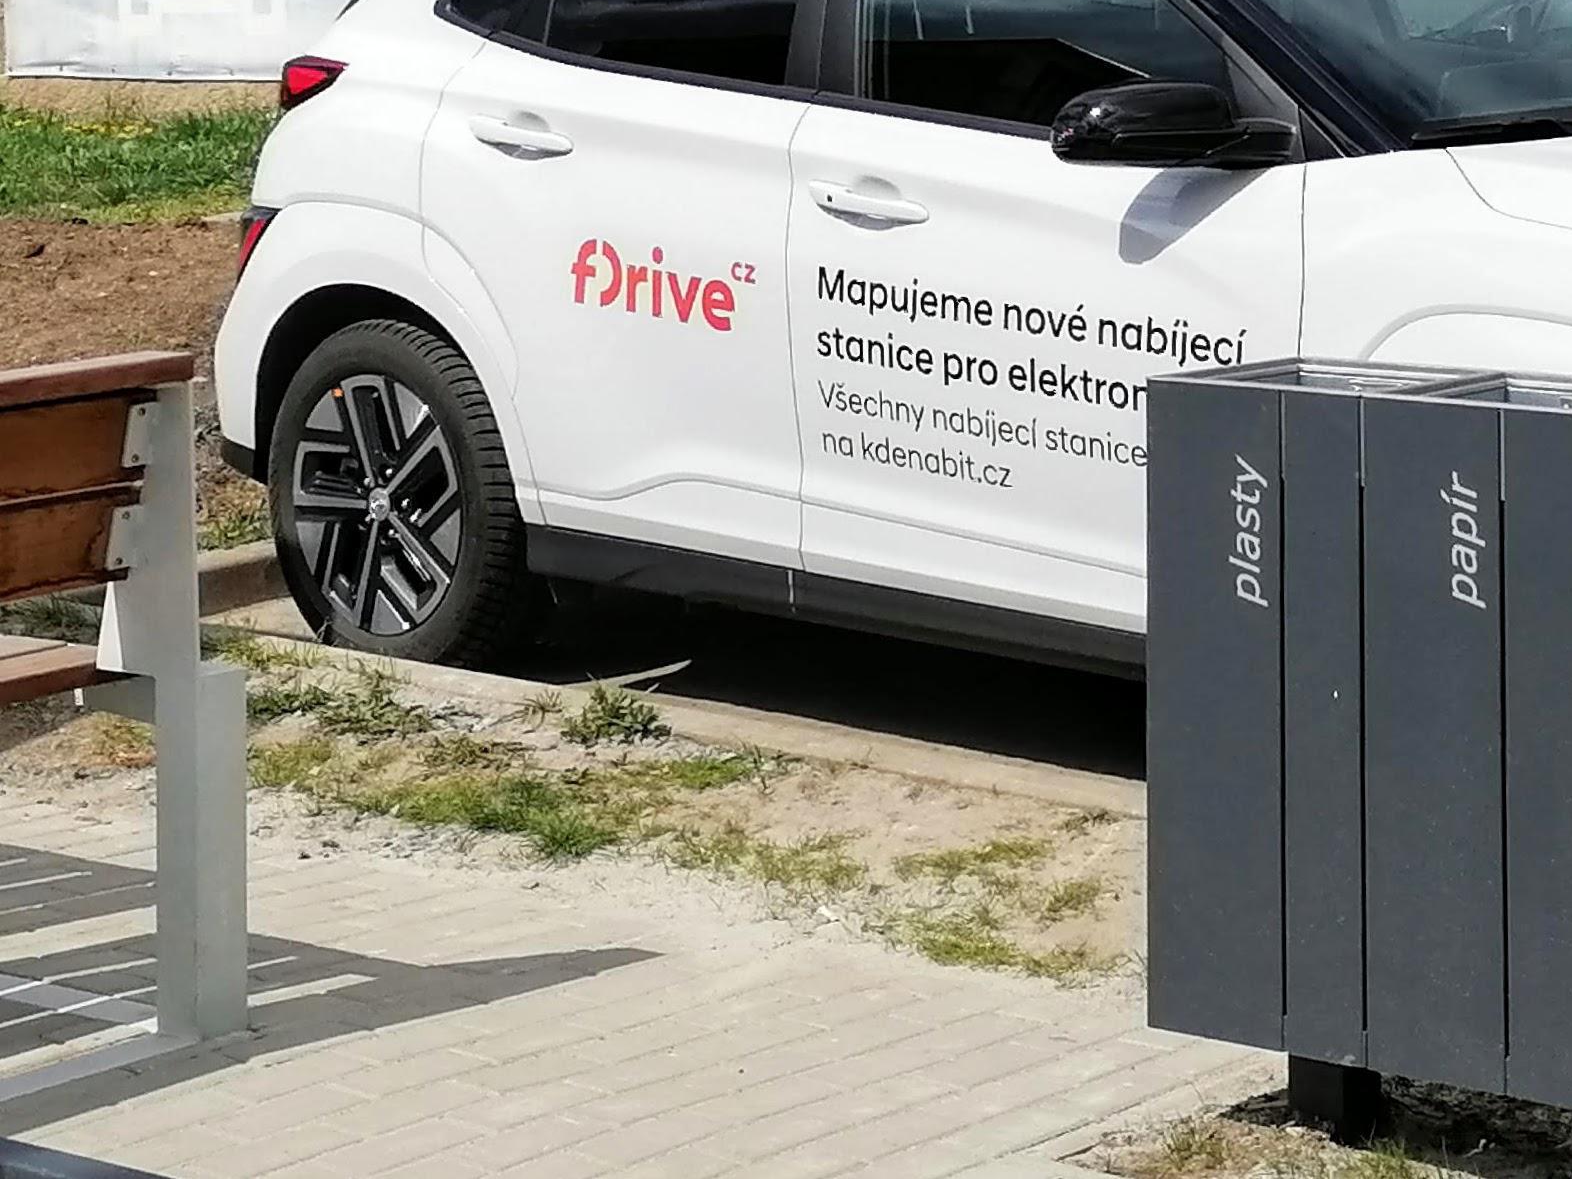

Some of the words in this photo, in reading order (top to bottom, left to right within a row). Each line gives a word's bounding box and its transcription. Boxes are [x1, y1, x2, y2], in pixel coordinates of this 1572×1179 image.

[817, 265, 993, 327] Mapujeme
[1003, 302, 1088, 343] nové
[1097, 315, 1247, 368] nabíjecí
[817, 327, 934, 375] stanice
[943, 352, 998, 386] pro
[817, 379, 925, 433] Všechny
[1045, 426, 1148, 467] stanice
[822, 431, 854, 458] na
[861, 431, 1013, 488] kdenabit.cz
[1228, 453, 1269, 608] plasty
[1440, 470, 1487, 609] papír
